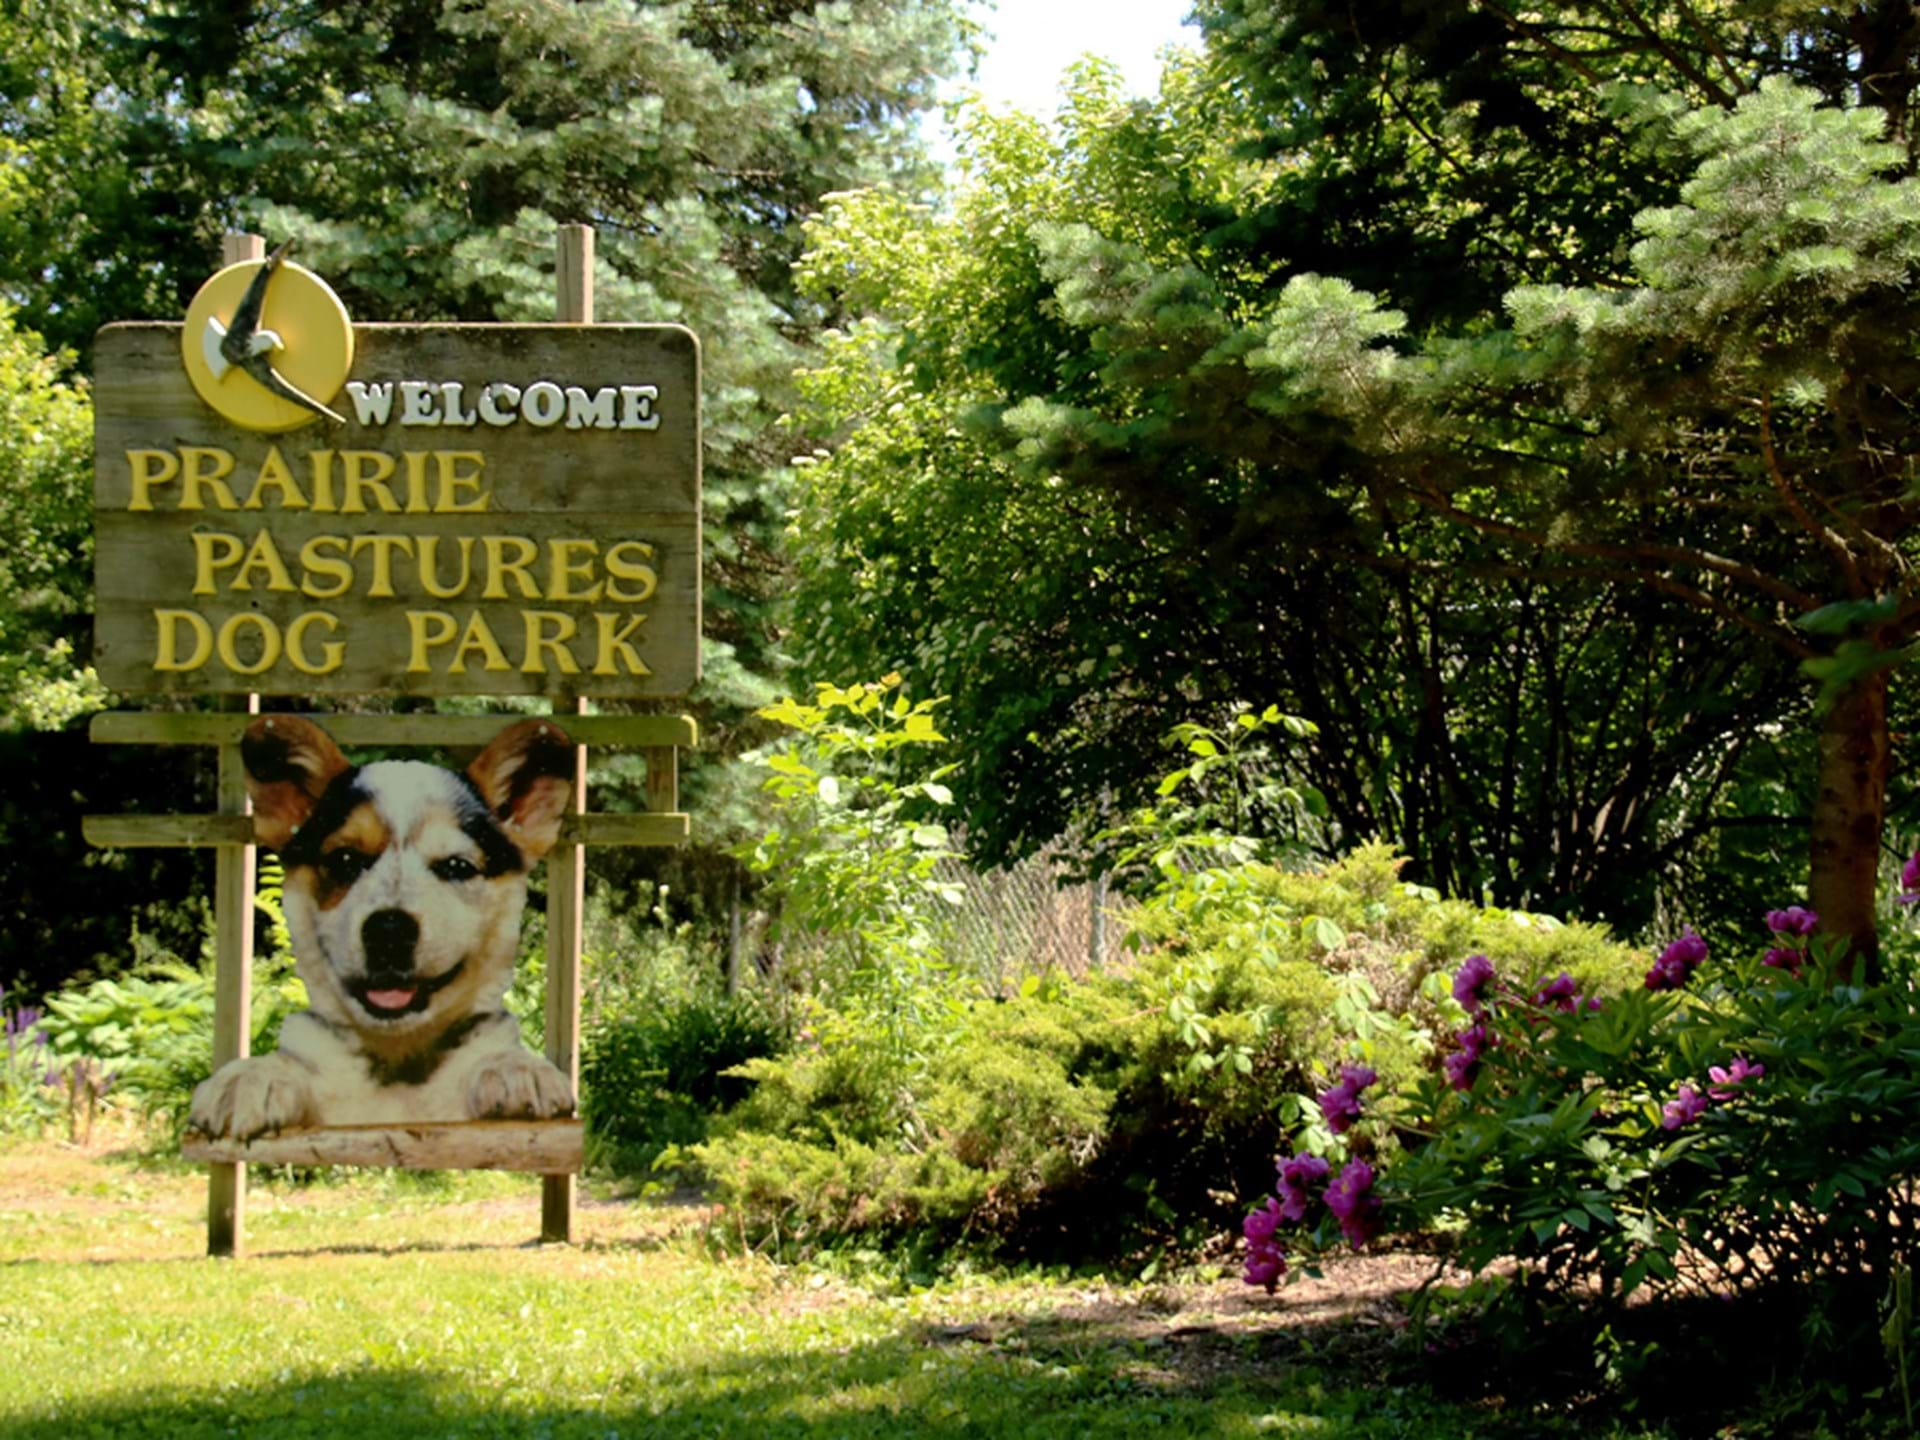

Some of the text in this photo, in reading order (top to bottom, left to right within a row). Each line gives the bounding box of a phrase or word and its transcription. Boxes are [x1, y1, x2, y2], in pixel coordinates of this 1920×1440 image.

[346, 380, 660, 431] WELCOME
[126, 445, 490, 513] PRAIRIE
[191, 529, 659, 602] PASTURES
[153, 608, 651, 676] DOG PARK
